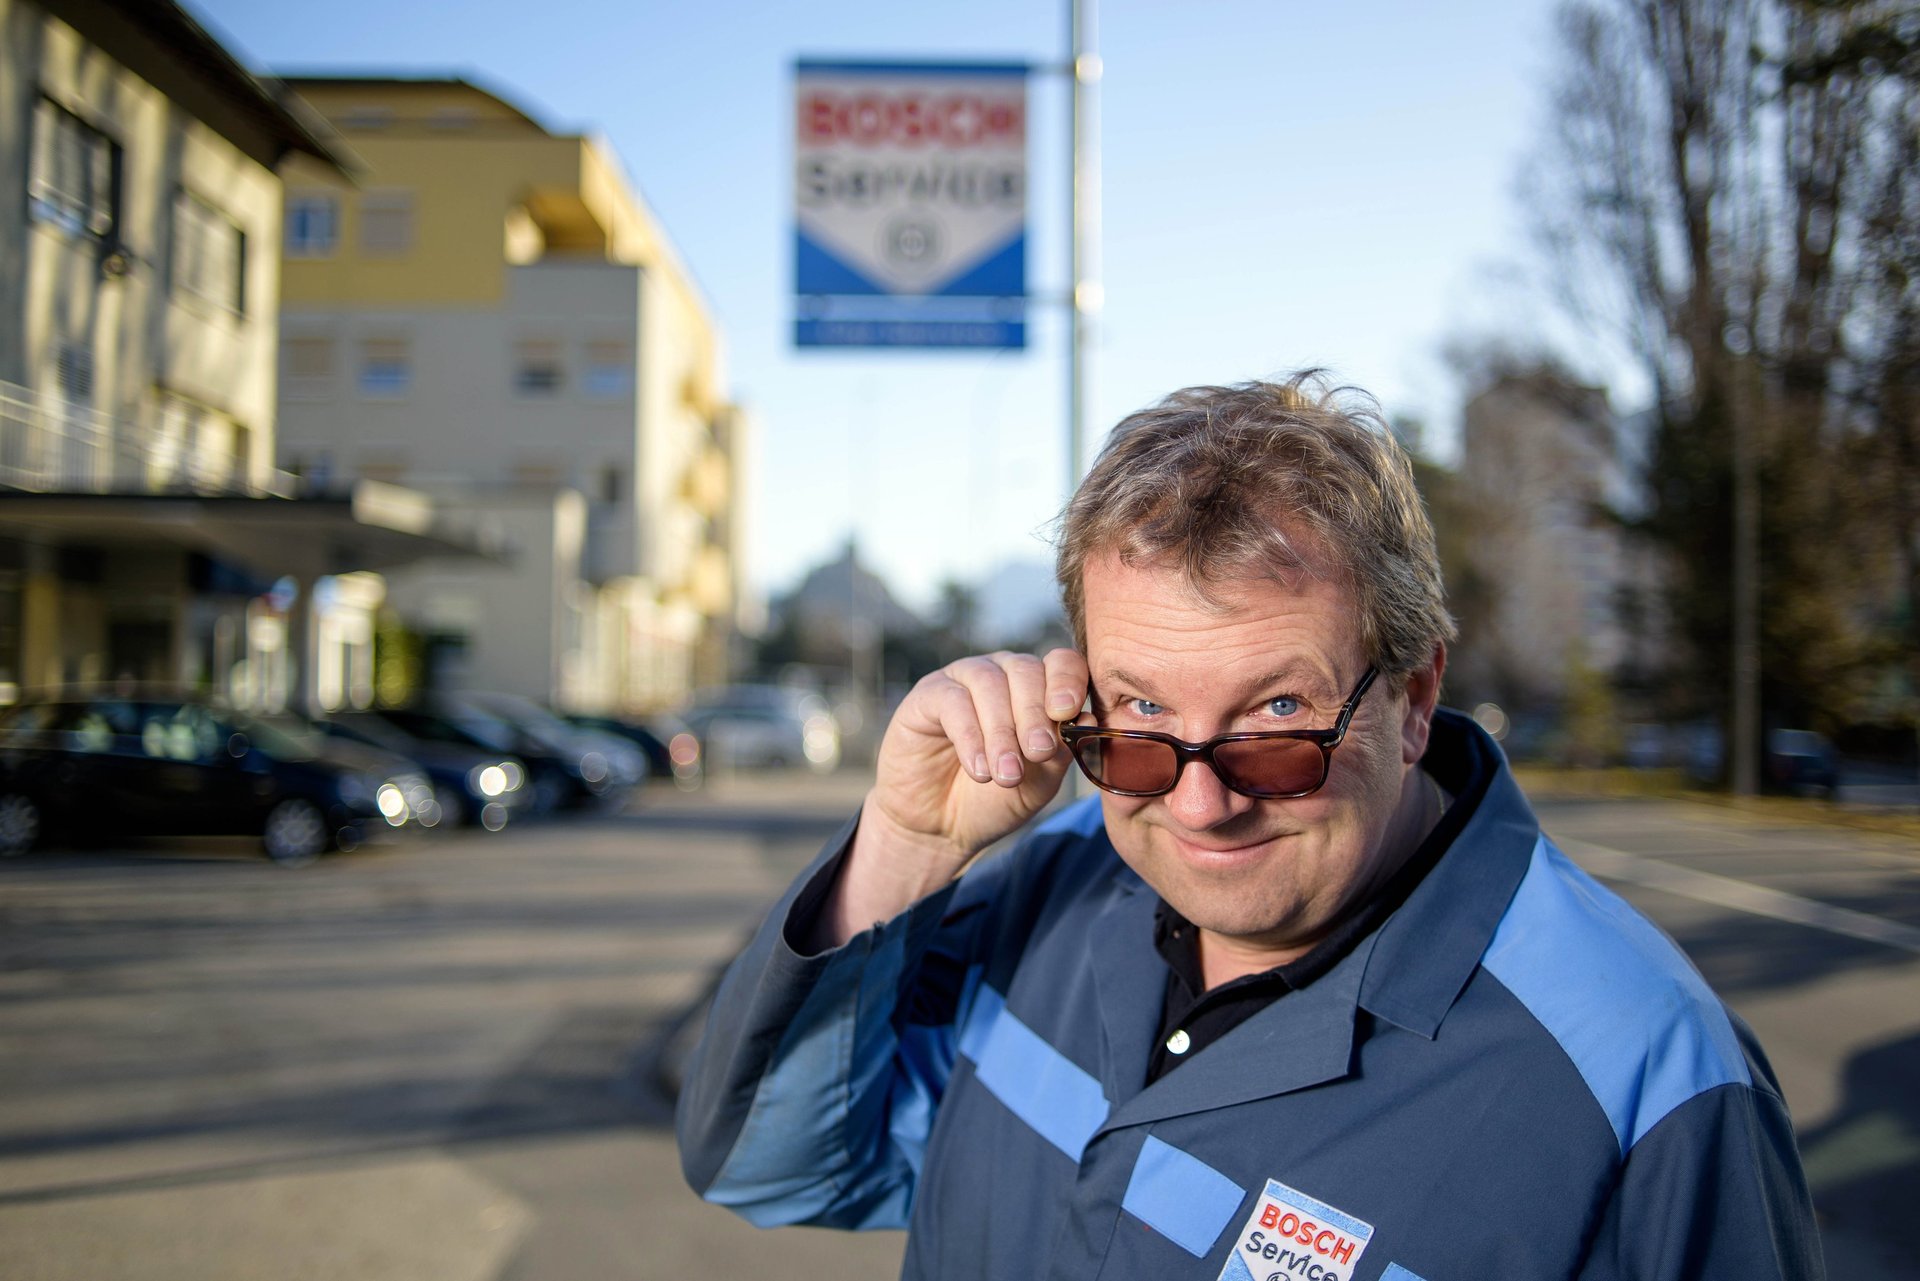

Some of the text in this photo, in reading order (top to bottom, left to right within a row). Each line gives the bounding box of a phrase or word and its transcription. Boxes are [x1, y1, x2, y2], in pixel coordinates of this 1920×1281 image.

[802, 93, 1022, 148] BOSCH
[801, 156, 1022, 207] Service
[1258, 1203, 1356, 1266] BOSCH
